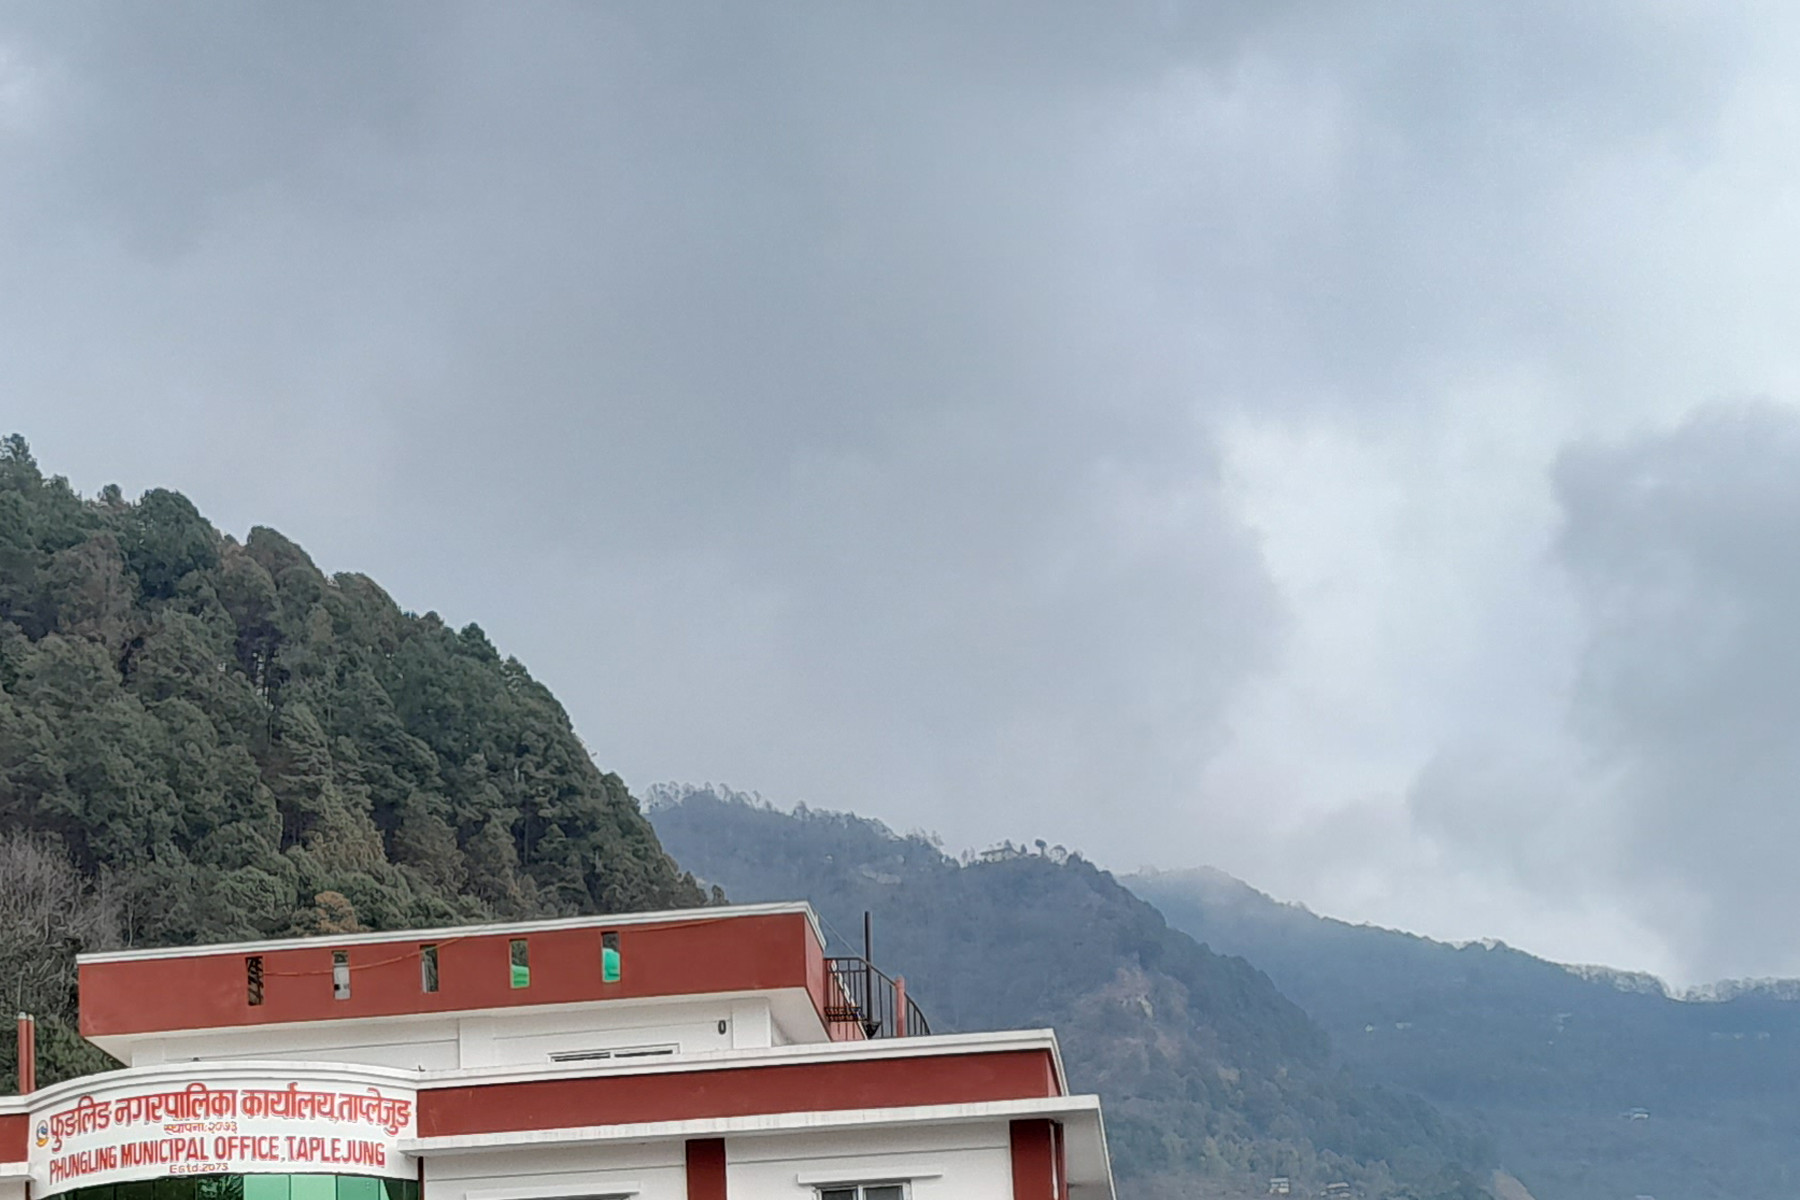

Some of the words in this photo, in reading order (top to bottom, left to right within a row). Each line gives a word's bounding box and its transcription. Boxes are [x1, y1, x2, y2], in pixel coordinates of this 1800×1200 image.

[114, 1083, 239, 1125] नगरपालिका
[49, 1145, 118, 1185] PHUNGLING
[121, 1136, 209, 1168] MUNICIPAL
[285, 1136, 386, 1168] TAPLEJUNG
